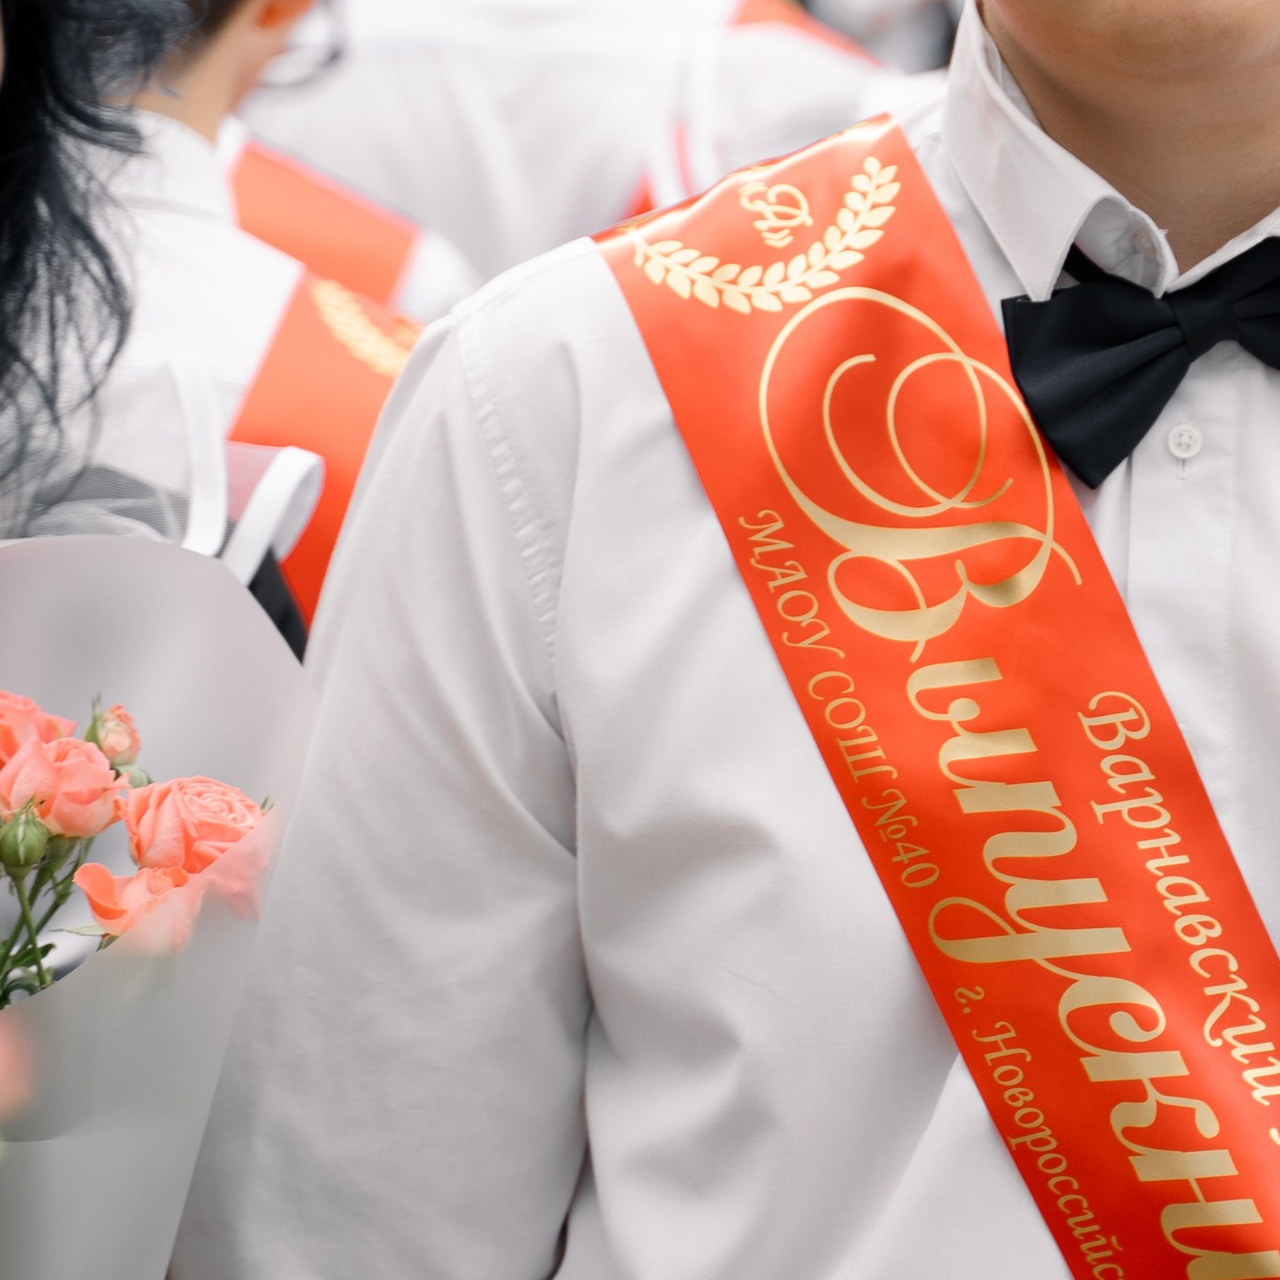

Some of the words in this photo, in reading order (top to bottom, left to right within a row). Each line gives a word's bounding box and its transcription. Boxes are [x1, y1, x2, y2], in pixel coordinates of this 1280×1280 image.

[739, 509, 845, 659] МАОУ
[808, 670, 898, 784] СОШ
[862, 788, 940, 889] №40
[955, 986, 985, 1015] г.
